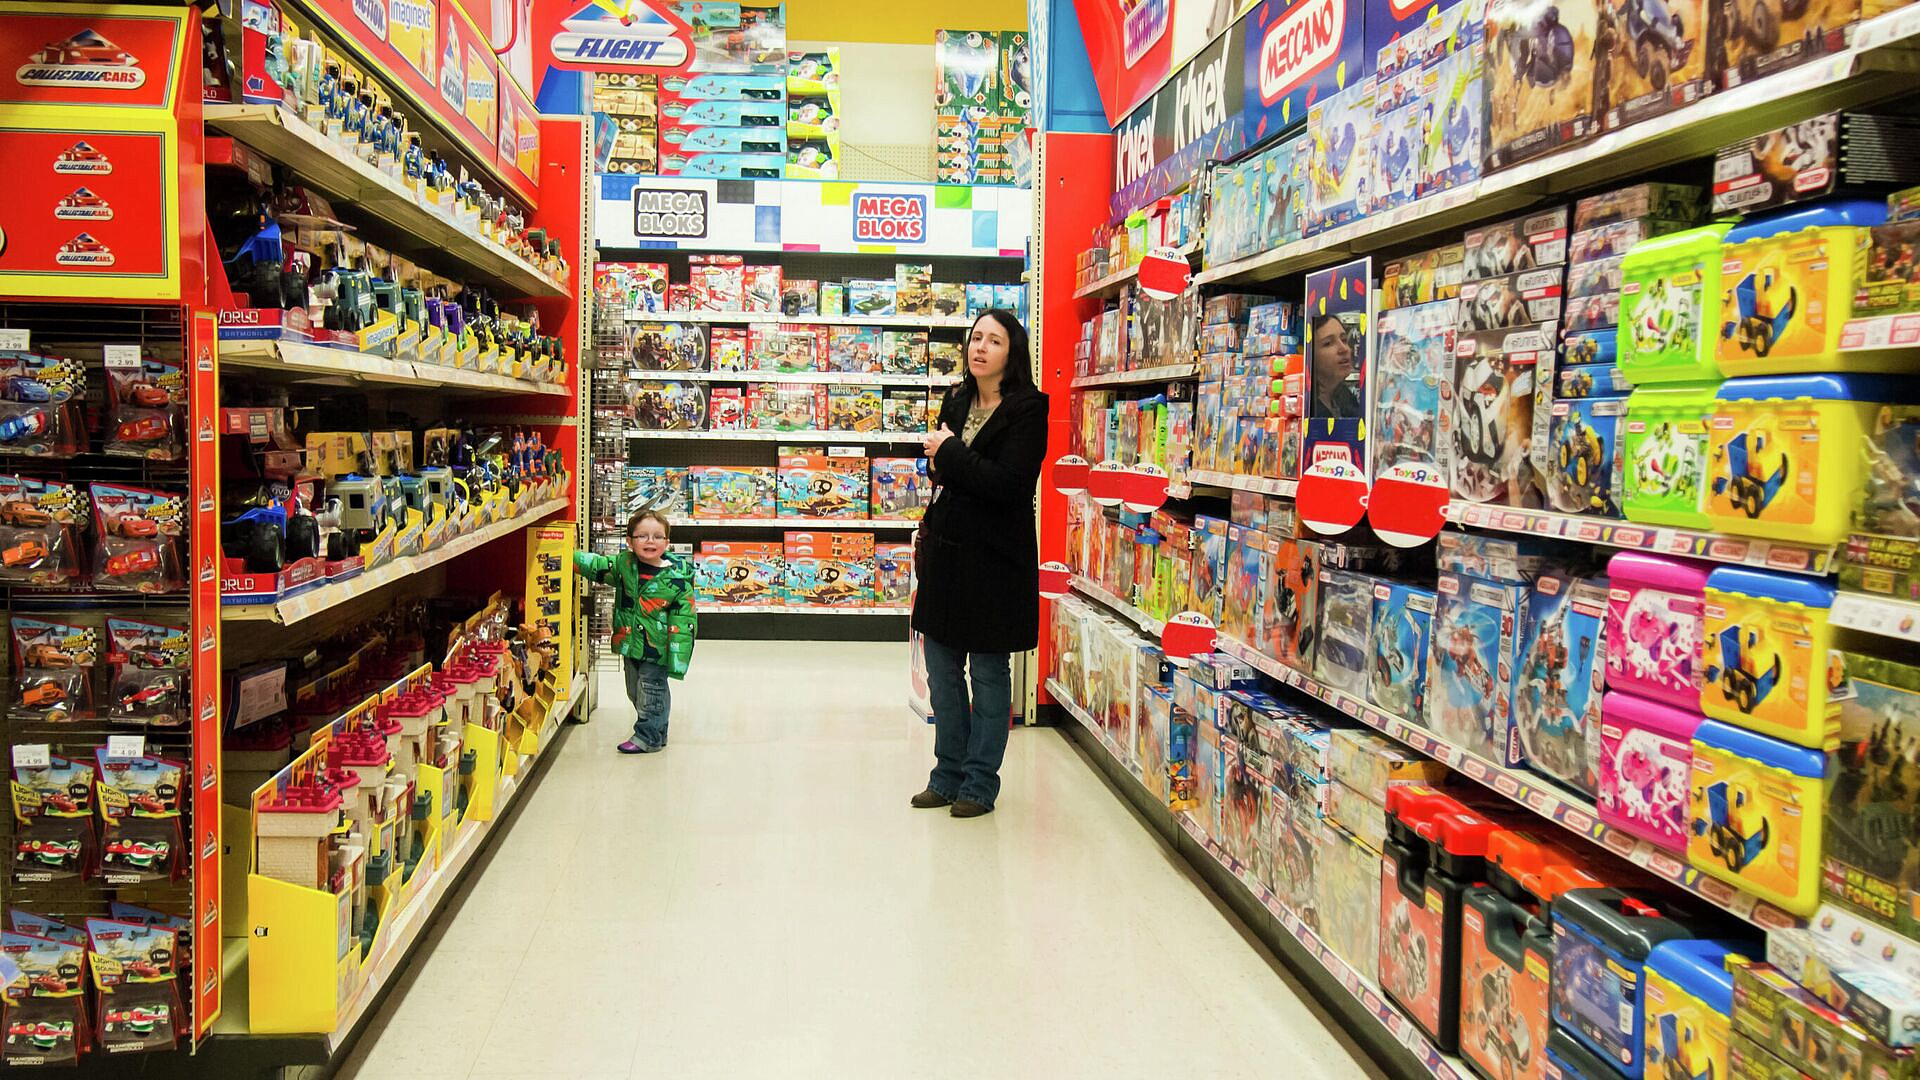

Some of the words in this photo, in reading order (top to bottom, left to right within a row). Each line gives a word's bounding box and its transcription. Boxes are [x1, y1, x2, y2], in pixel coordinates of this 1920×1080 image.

[390, 0, 432, 31] imaginext
[574, 38, 664, 60] FLIGHT
[1264, 4, 1335, 88] MECCANO
[468, 81, 494, 104] imaginext
[640, 193, 704, 213] MEGA
[859, 199, 921, 217] MEGA
[640, 215, 704, 234] BLOKS
[858, 221, 922, 237] BLOKS
[1869, 551, 1912, 568] FORCES
[1845, 885, 1897, 918] FORCES
